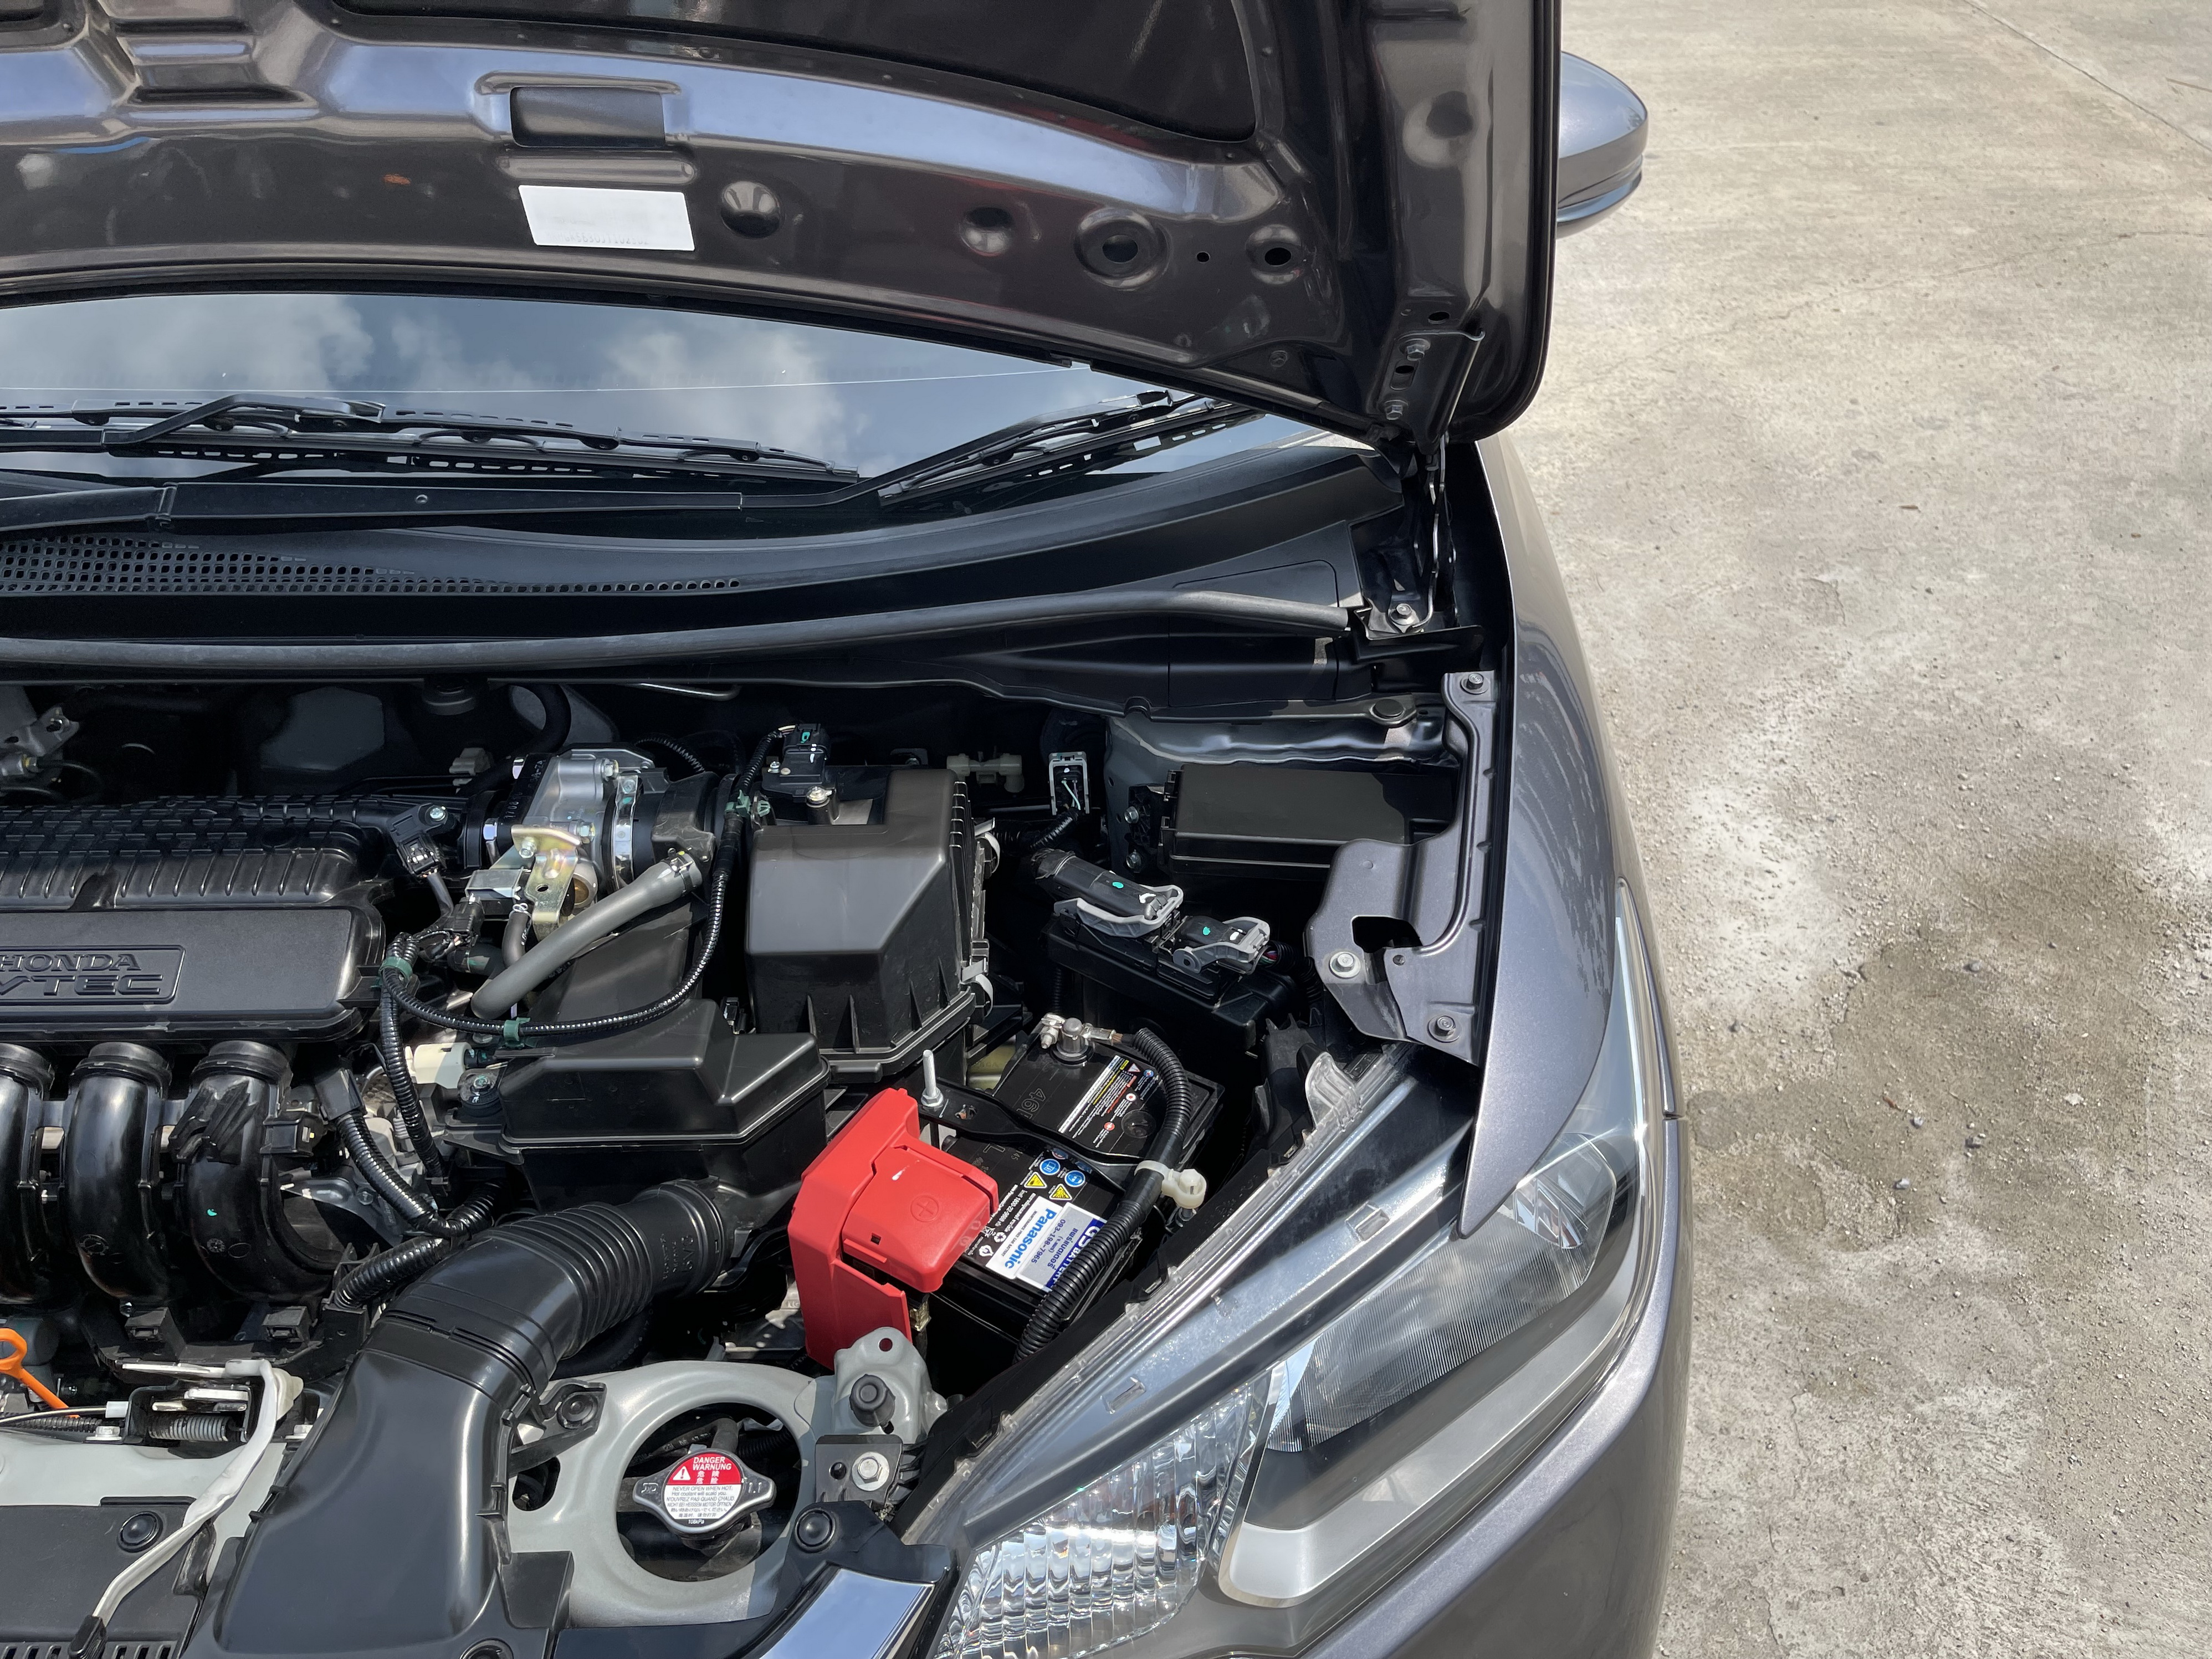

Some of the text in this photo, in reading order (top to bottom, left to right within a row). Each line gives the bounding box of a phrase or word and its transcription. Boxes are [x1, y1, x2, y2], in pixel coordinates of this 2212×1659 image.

[0, 954, 142, 972] HONDA
[0, 974, 163, 996] VTEC
[1004, 1208, 1057, 1269] Panasonic
[1031, 1218, 1066, 1264] 093-198-7965
